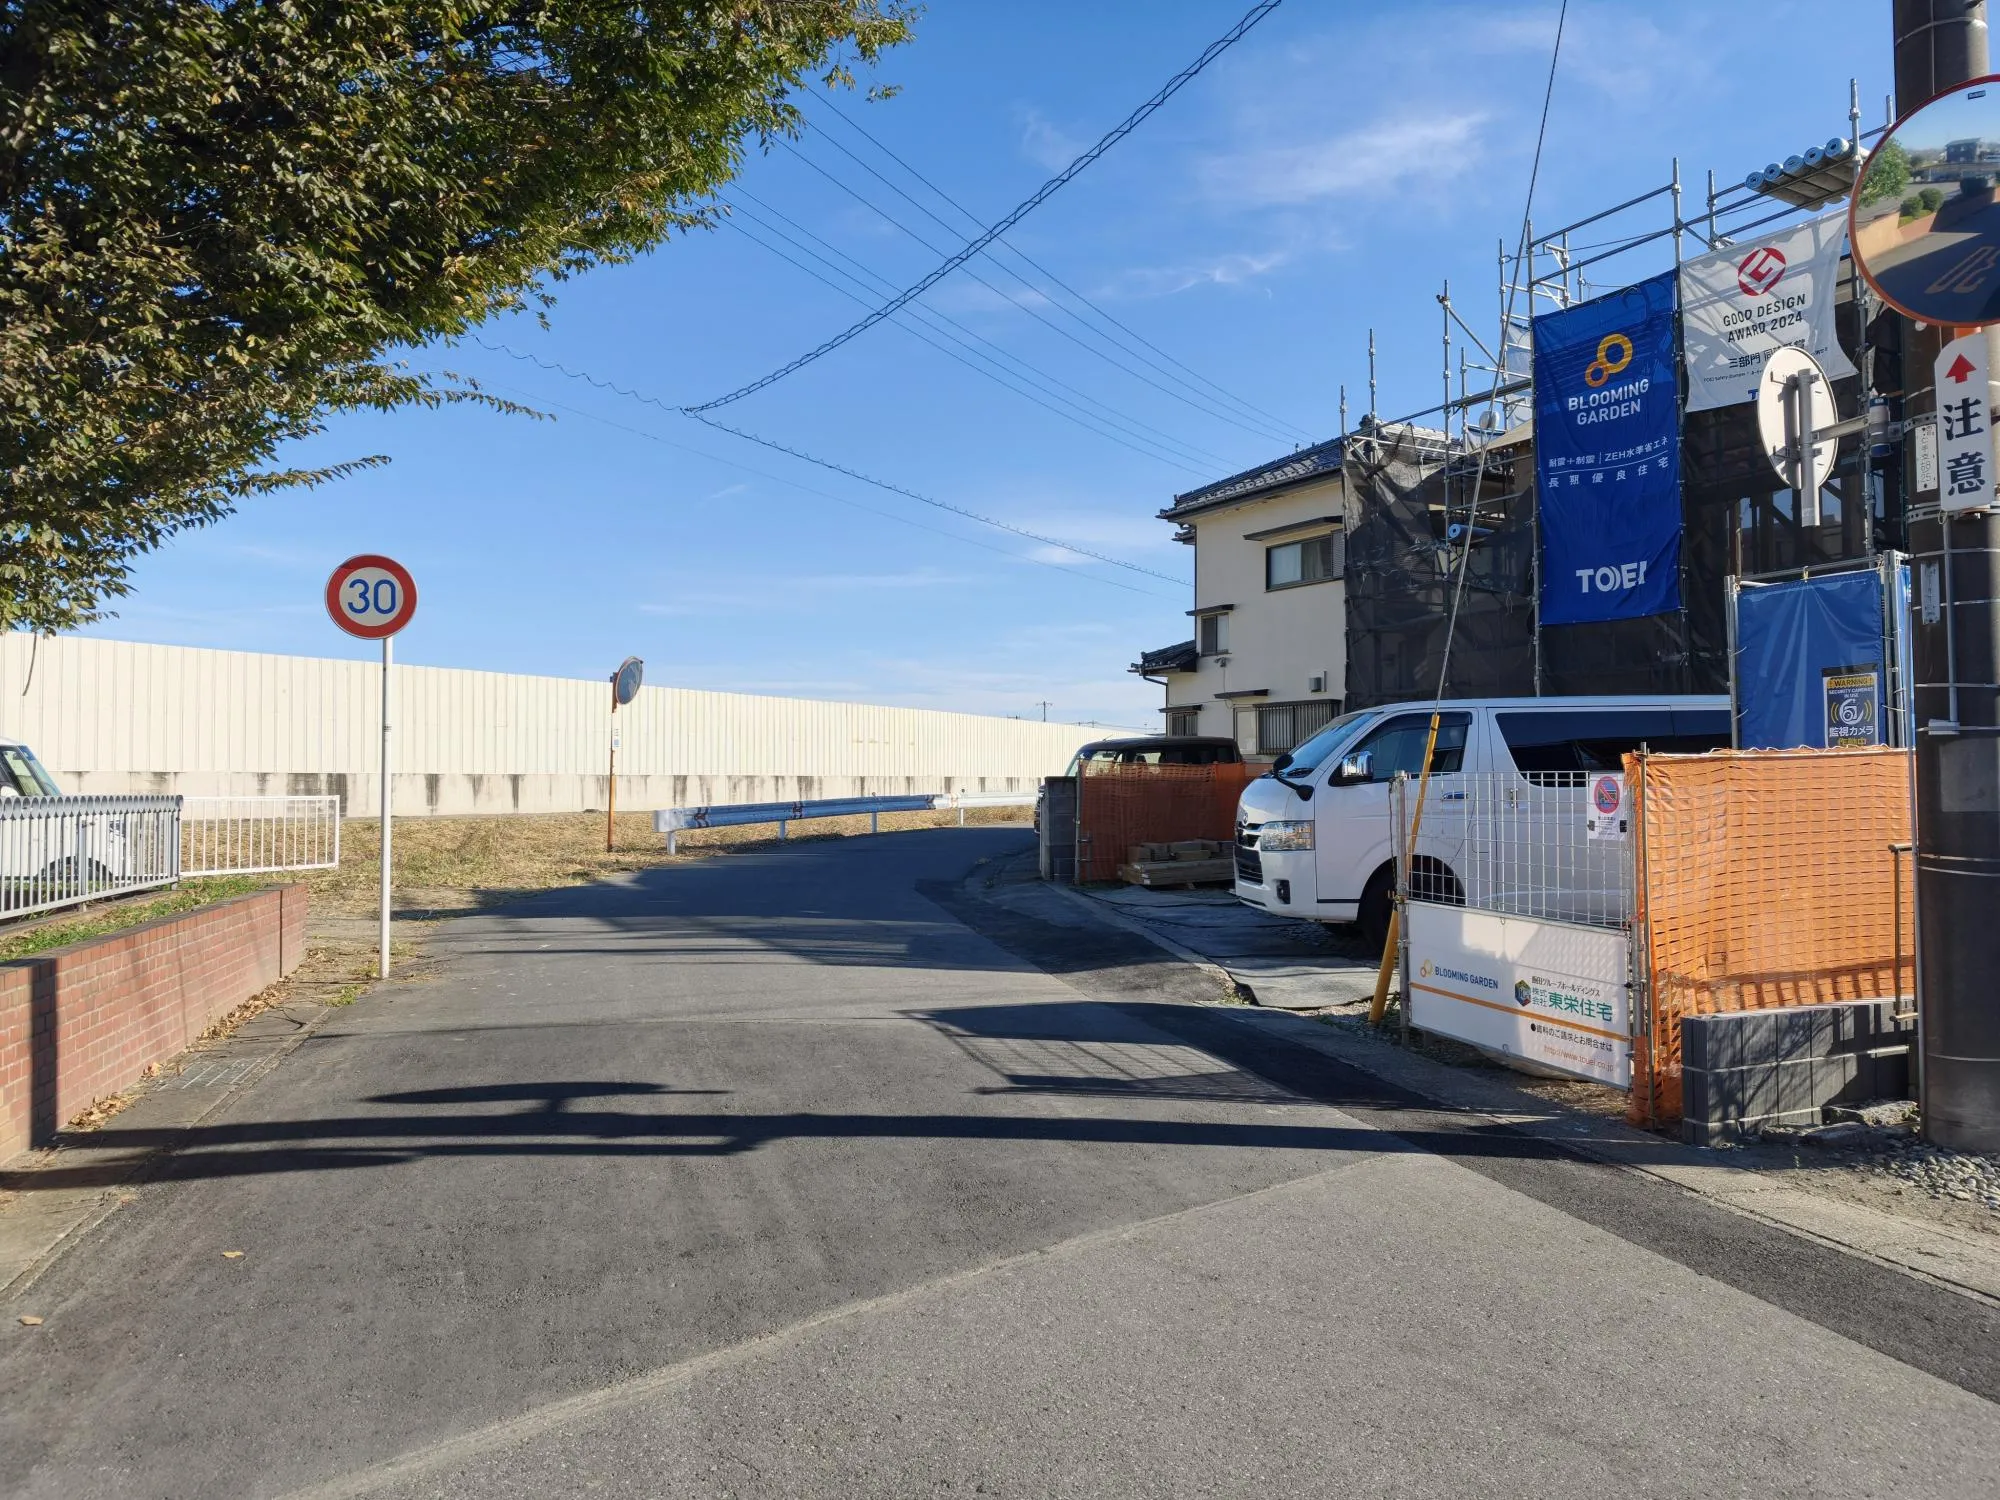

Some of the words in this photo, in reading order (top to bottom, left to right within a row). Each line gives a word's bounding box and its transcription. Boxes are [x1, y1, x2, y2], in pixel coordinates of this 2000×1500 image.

[1723, 310, 1753, 327] GOOD
[1757, 293, 1806, 317] DESIGN
[1727, 322, 1766, 343] AWARD
[1770, 311, 1803, 331] 2024
[1728, 353, 1761, 369] 三部門
[1568, 378, 1650, 412] BLOOMING
[1577, 398, 1641, 425] GARDEN
[1943, 396, 1986, 497] 注意
[1548, 456, 1670, 489] 長期優良住宅
[347, 578, 397, 615] 30
[1829, 725, 1874, 737] 監視カメラ
[1435, 966, 1469, 983] BLOOMING
[1470, 974, 1499, 990] GARDEN
[1548, 992, 1613, 1022] 東栄住宅
